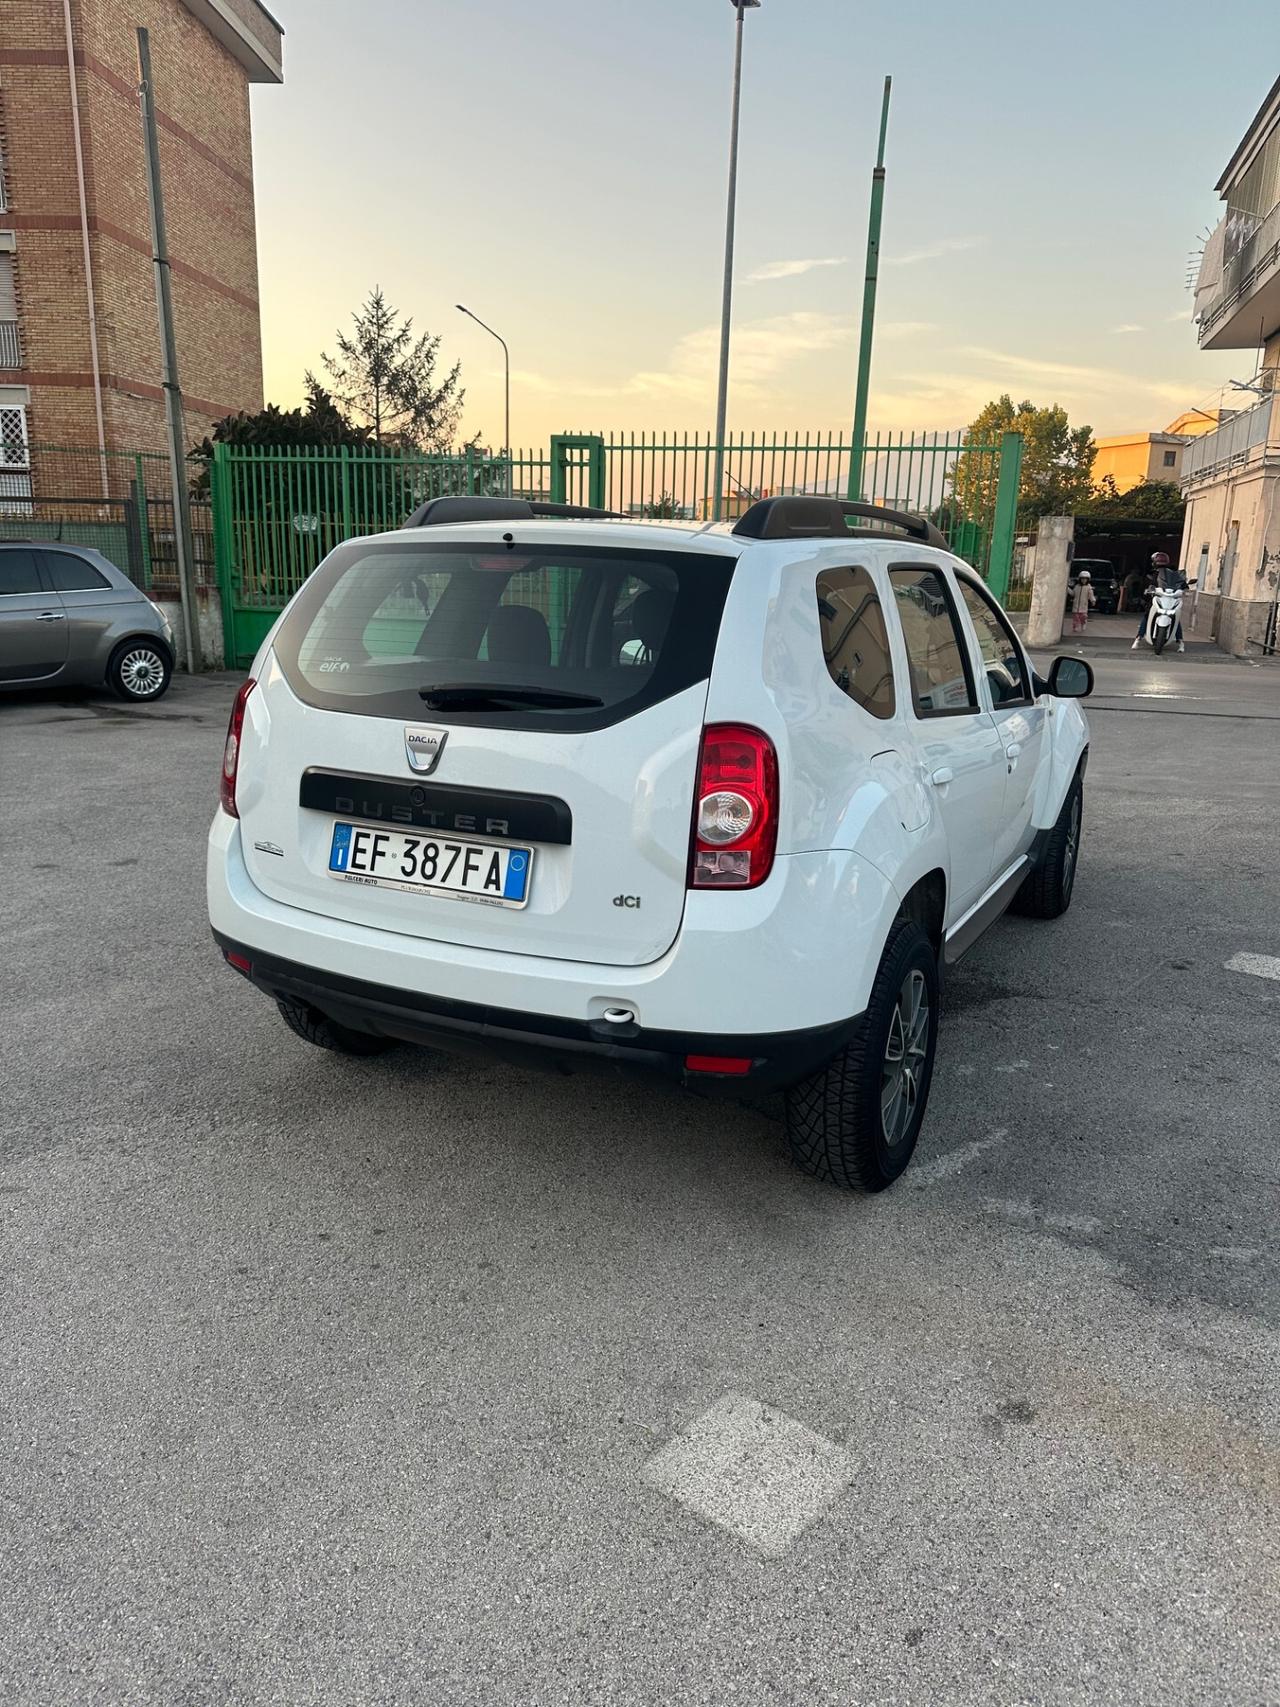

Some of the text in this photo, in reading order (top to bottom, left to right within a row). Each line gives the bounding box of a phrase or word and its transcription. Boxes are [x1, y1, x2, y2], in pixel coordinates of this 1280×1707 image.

[408, 735, 437, 744] DACIA
[336, 797, 508, 834] DUSTER
[351, 831, 501, 891] EF 387FA
[612, 894, 641, 909] dCi
